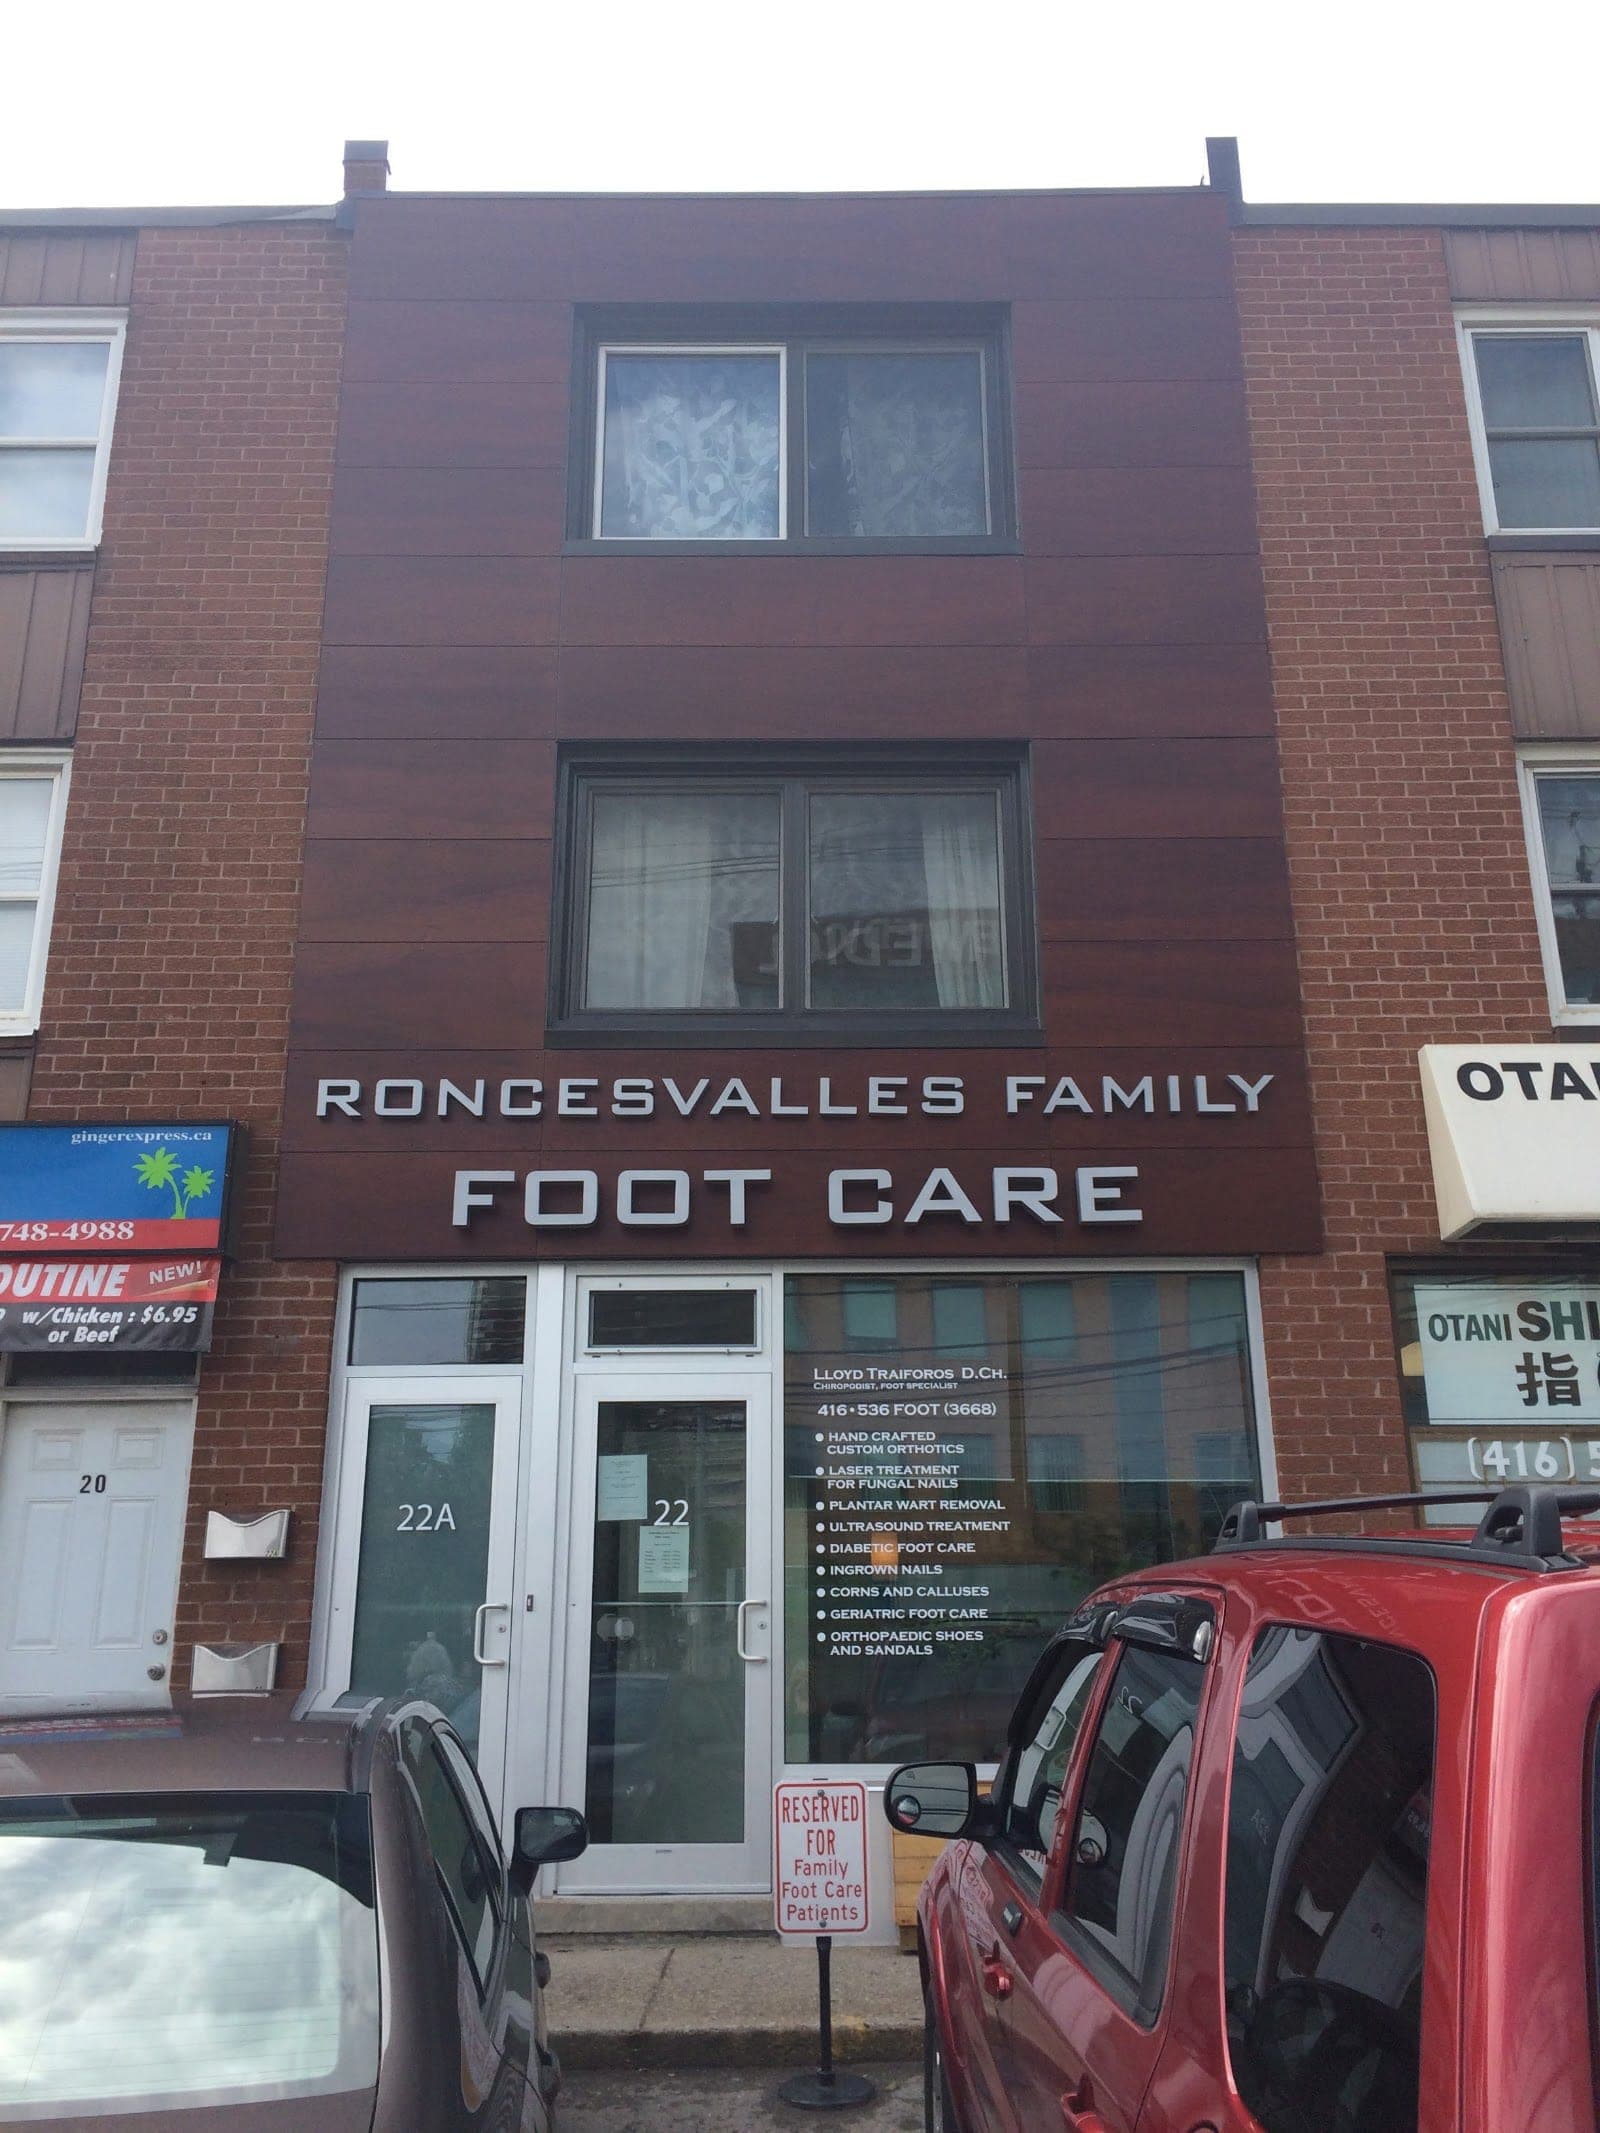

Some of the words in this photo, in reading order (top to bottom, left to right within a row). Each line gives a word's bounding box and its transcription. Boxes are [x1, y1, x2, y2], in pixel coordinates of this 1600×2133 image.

[315, 1076, 965, 1116] RONCESVALLES
[1005, 1074, 1275, 1115] FAMILY
[71, 1130, 213, 1145] gingerexpress.ca
[452, 1168, 772, 1226] FOOT
[828, 1166, 1144, 1225] CARE
[0, 1221, 135, 1241] 748-4988
[149, 1260, 203, 1285] NEW!
[22, 1306, 123, 1325] w/Chicken
[141, 1305, 198, 1325] $6.95
[48, 1329, 67, 1343] or
[74, 1326, 119, 1343] Beef
[1428, 1313, 1513, 1342] OTANI
[866, 1368, 954, 1380] TRAIFOROS
[1515, 1352, 1581, 1407] 指
[893, 1404, 940, 1416] FOOT
[944, 1402, 997, 1417] (3668)
[828, 1432, 869, 1442] HAND
[872, 1432, 936, 1442] CRAFTED
[826, 1444, 884, 1455] CUSTOM
[887, 1444, 965, 1454] ORTHOTICS
[1467, 1436, 1576, 1480] (416)
[829, 1465, 874, 1476] LASER
[876, 1465, 960, 1476] TREATMENT
[79, 1474, 107, 1494] 20
[827, 1480, 856, 1489] FOR
[858, 1480, 915, 1489] FUNGAL
[917, 1479, 959, 1489] NAILS
[653, 1499, 690, 1526] 22
[829, 1501, 894, 1511] PLANTAR
[896, 1500, 937, 1511] WART
[939, 1500, 1006, 1511] REMOVAL
[396, 1503, 456, 1531] 22A
[829, 1522, 924, 1532] ULTRASOUND
[926, 1521, 1011, 1532] TREATMENT
[830, 1543, 894, 1554] DIABETIC
[897, 1543, 935, 1554] FOOT
[936, 1543, 976, 1553] CARE
[830, 1565, 898, 1575] INGROWN
[901, 1565, 943, 1575] NAILS
[830, 1587, 879, 1598] CORNS
[882, 1587, 913, 1597] AND
[915, 1586, 990, 1597] CALLUSES
[830, 1609, 905, 1620] GERIATRIC
[908, 1609, 946, 1619] FOOT
[948, 1608, 989, 1619] CARE
[830, 1631, 932, 1642] ORTHOPAEDIC
[935, 1630, 984, 1641] SHOES
[830, 1646, 862, 1656] AND
[864, 1645, 934, 1656] SANDALS
[782, 1795, 860, 1823] RESERVED
[806, 1829, 836, 1856] FOR
[794, 1859, 849, 1880] Family
[782, 1881, 817, 1899] Foot
[824, 1881, 862, 1898] Care
[787, 1903, 859, 1921] Patients
